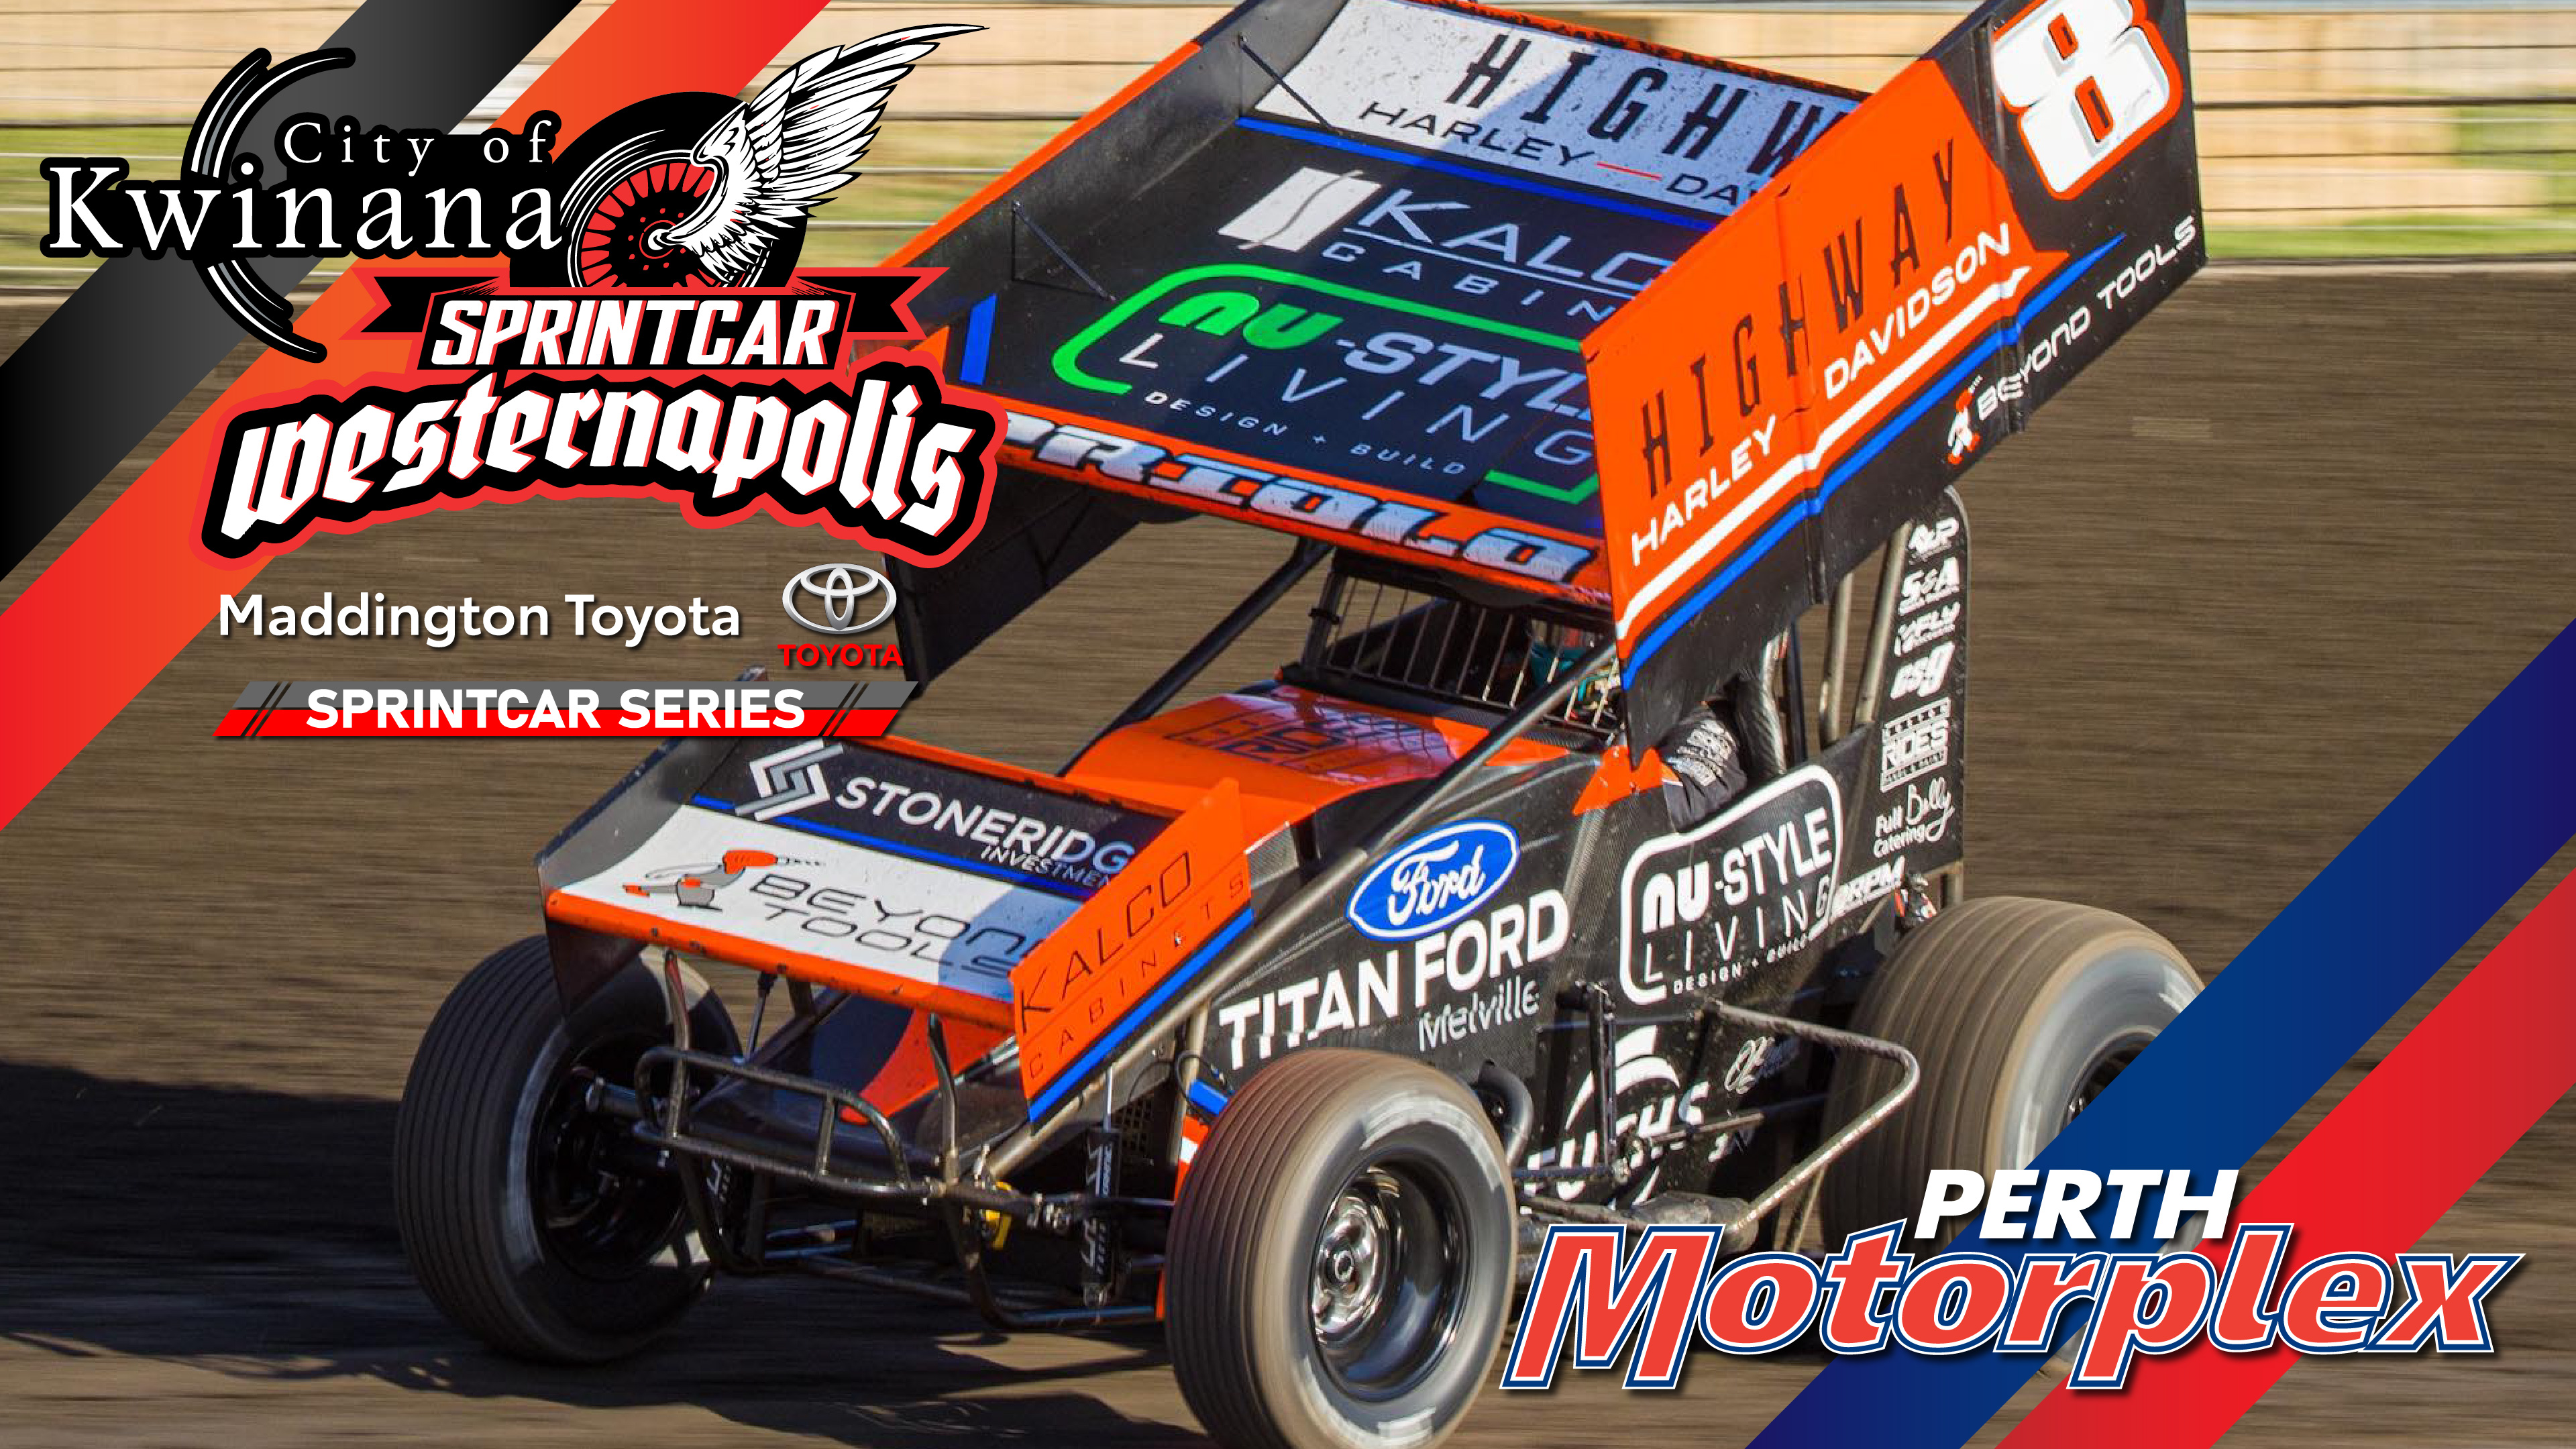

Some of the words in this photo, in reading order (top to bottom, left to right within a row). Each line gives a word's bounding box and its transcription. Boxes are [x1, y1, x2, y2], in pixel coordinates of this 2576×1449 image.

[1359, 101, 1595, 166] HARLEY
[1665, 174, 1758, 206] DA
[1992, 0, 2181, 199] 8
[1159, 291, 1592, 421] NU-STYL
[1641, 138, 1955, 499] HIGHWAY
[1977, 306, 2091, 421] BEYOND
[2096, 215, 2197, 309] TOOLS
[1118, 333, 1594, 465] LIVING
[1144, 392, 1287, 436] DESIGN
[1350, 444, 1468, 475] BUILD
[1631, 415, 1777, 565] HARLEY
[1824, 223, 2010, 399] DAVIDSON
[749, 873, 1044, 959] BEYON
[764, 903, 1018, 979] TOOLS
[1020, 851, 1191, 1034] KALCO
[1387, 840, 1486, 926] Ford
[1645, 874, 1831, 983] LIVING
[1028, 873, 1245, 1080] CABINETS
[1218, 949, 1399, 1071] TITAN
[1414, 890, 1570, 1008] FORD
[1417, 975, 1541, 1053] Melville
[1673, 961, 1742, 995] DESIGN
